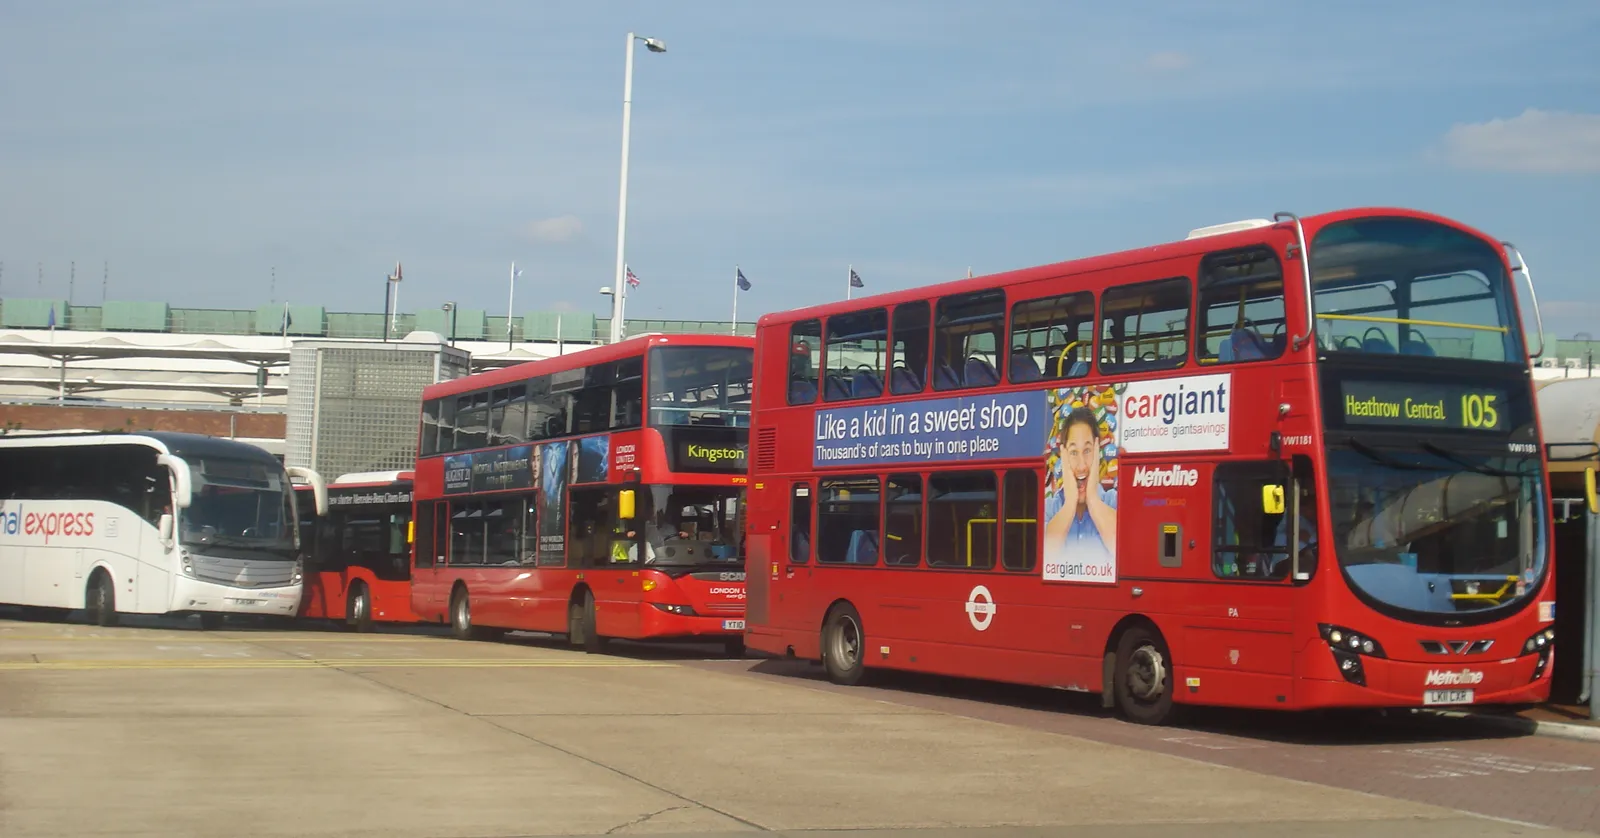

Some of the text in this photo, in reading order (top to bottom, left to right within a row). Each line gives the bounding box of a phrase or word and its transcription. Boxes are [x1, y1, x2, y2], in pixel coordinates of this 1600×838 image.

[1125, 382, 1226, 424] cargiant
[1346, 394, 1446, 420] Heathrow Central
[1462, 394, 1497, 428] 105
[816, 399, 1028, 440] Like a kid in a sweet shop
[1123, 422, 1226, 441] giantchoice giantsavings
[1283, 435, 1312, 445] VW1181
[616, 444, 635, 454] LONDON
[688, 444, 745, 462] Kingston
[816, 435, 999, 460] Thousand's of cars to buy in one place
[1508, 443, 1537, 453] VW1181
[616, 454, 635, 464] UNITED
[1132, 464, 1198, 487] Metroline
[25, 512, 94, 545] express
[1045, 561, 1112, 578] cargiant.co.uk
[1228, 607, 1239, 617] PA
[1424, 668, 1484, 686] Metroline
